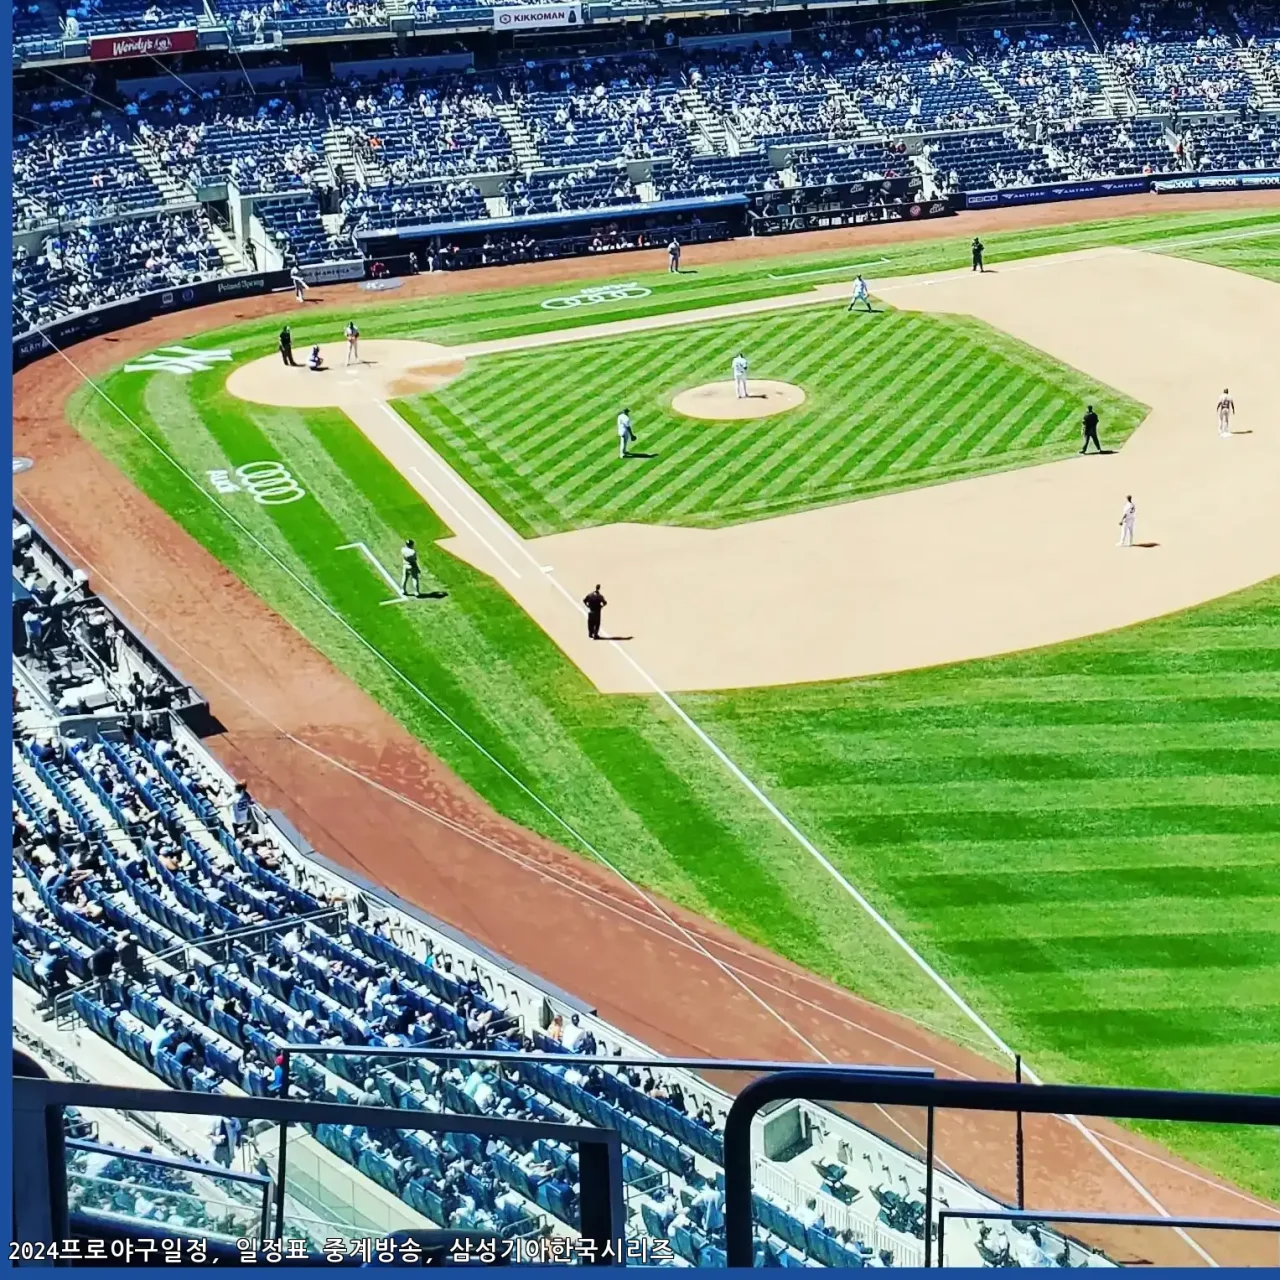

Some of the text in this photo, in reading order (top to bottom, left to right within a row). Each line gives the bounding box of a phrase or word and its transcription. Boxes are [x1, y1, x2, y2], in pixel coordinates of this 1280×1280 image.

[514, 12, 565, 22] KIKKOMAN
[113, 39, 153, 56] Wendy's
[968, 195, 998, 204] GEICO
